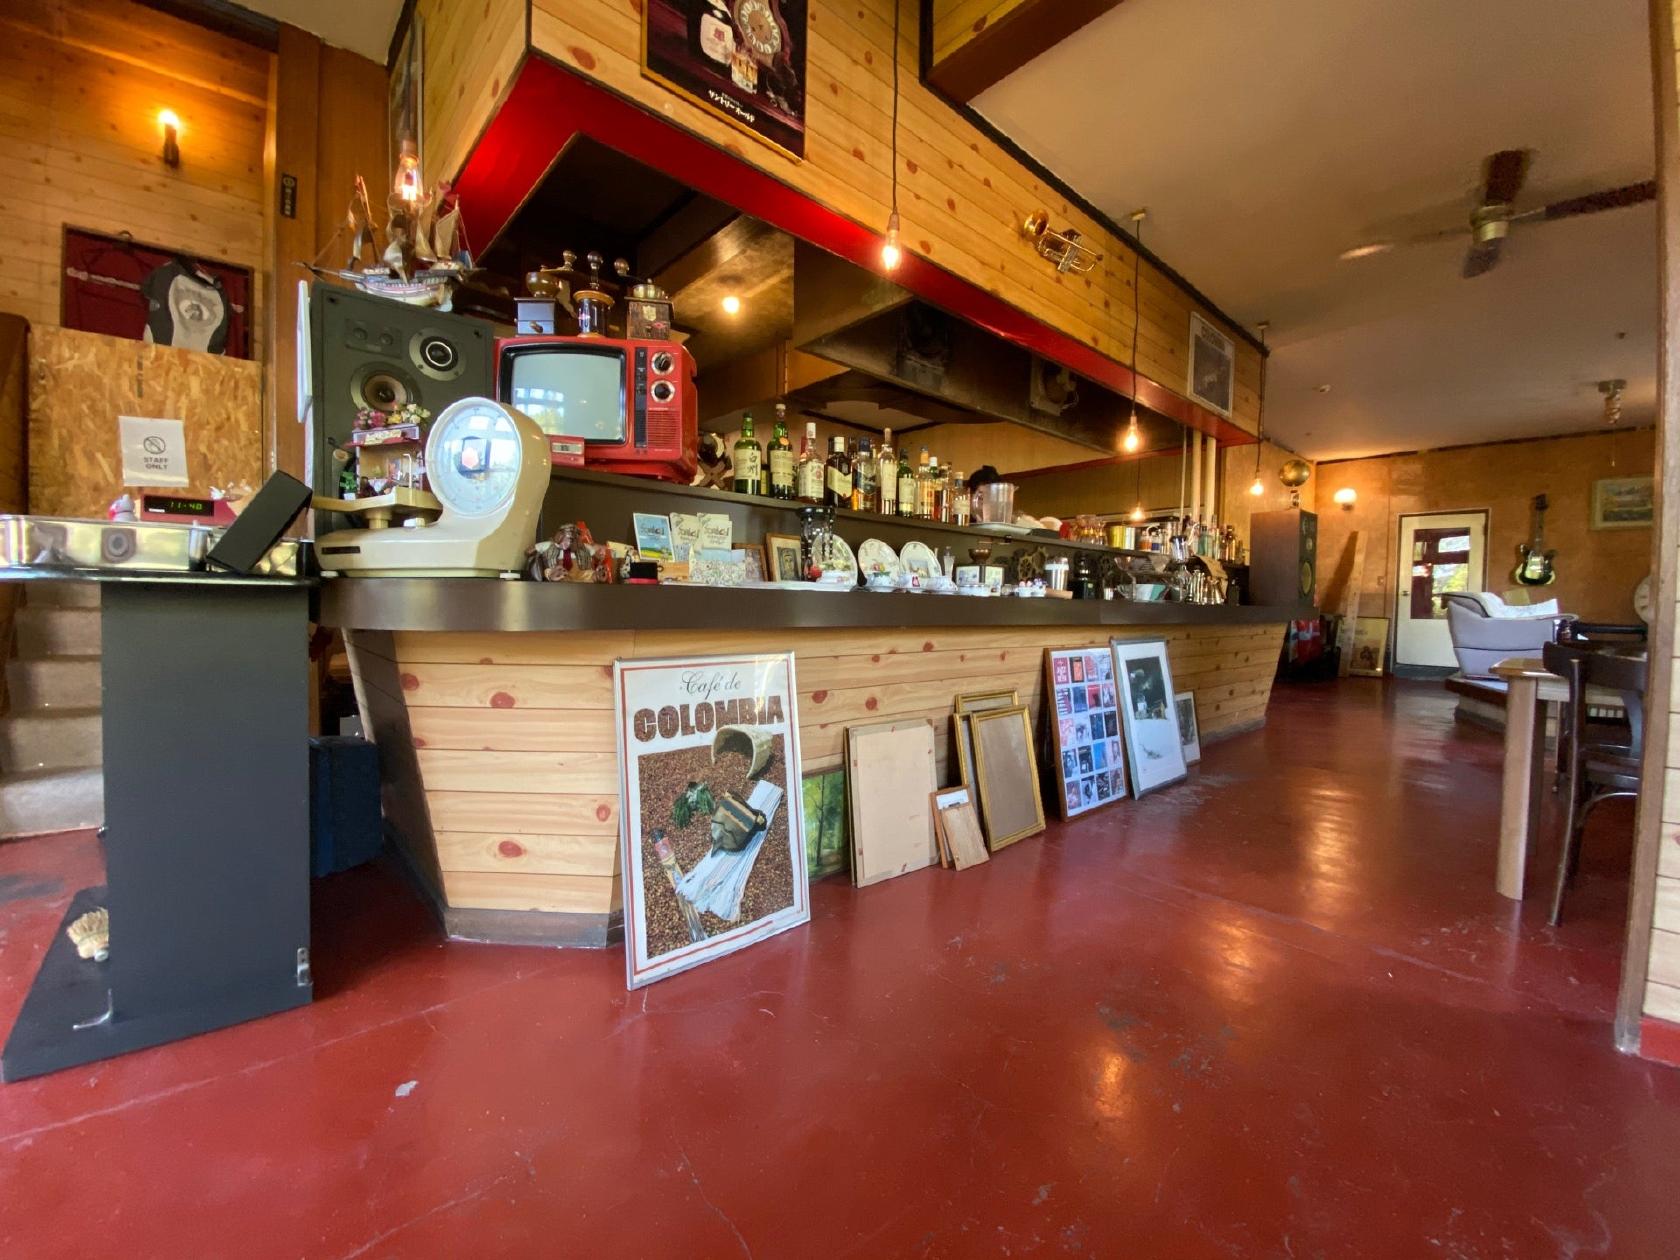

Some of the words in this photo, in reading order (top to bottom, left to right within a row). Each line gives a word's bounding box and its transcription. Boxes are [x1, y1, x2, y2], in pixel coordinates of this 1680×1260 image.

[679, 670, 724, 700] Café
[725, 672, 742, 690] de
[633, 695, 784, 742] COLOMBIA
